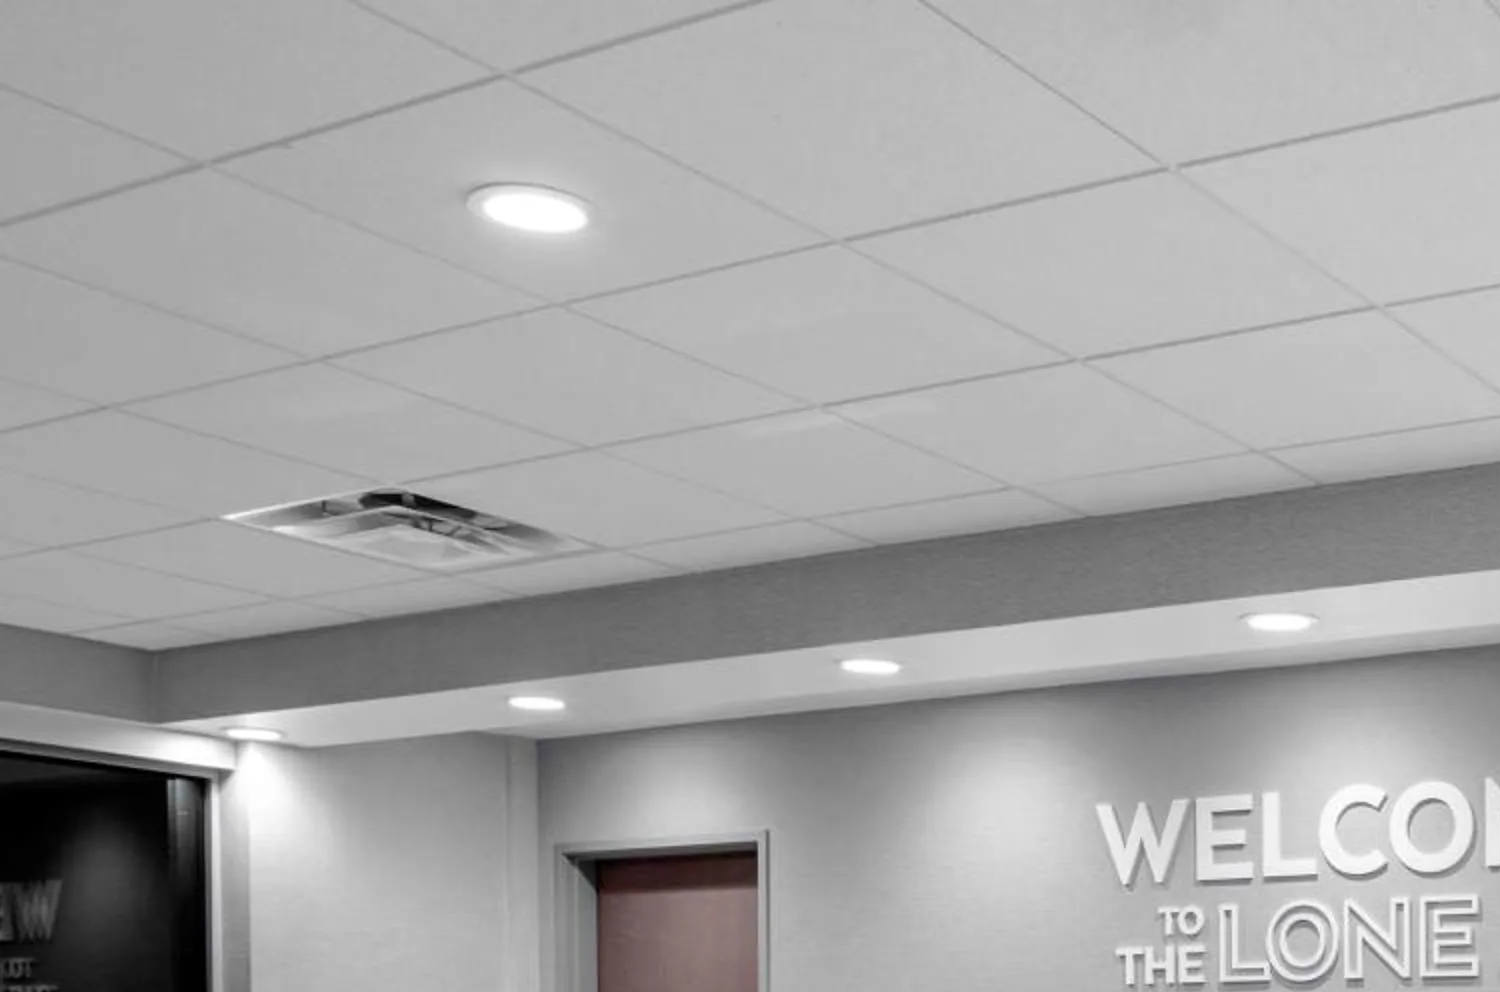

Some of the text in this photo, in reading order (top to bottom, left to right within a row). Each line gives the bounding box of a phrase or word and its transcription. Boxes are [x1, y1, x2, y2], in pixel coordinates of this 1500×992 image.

[1116, 894, 1481, 985] THE LONE
[1158, 906, 1205, 936] TO
